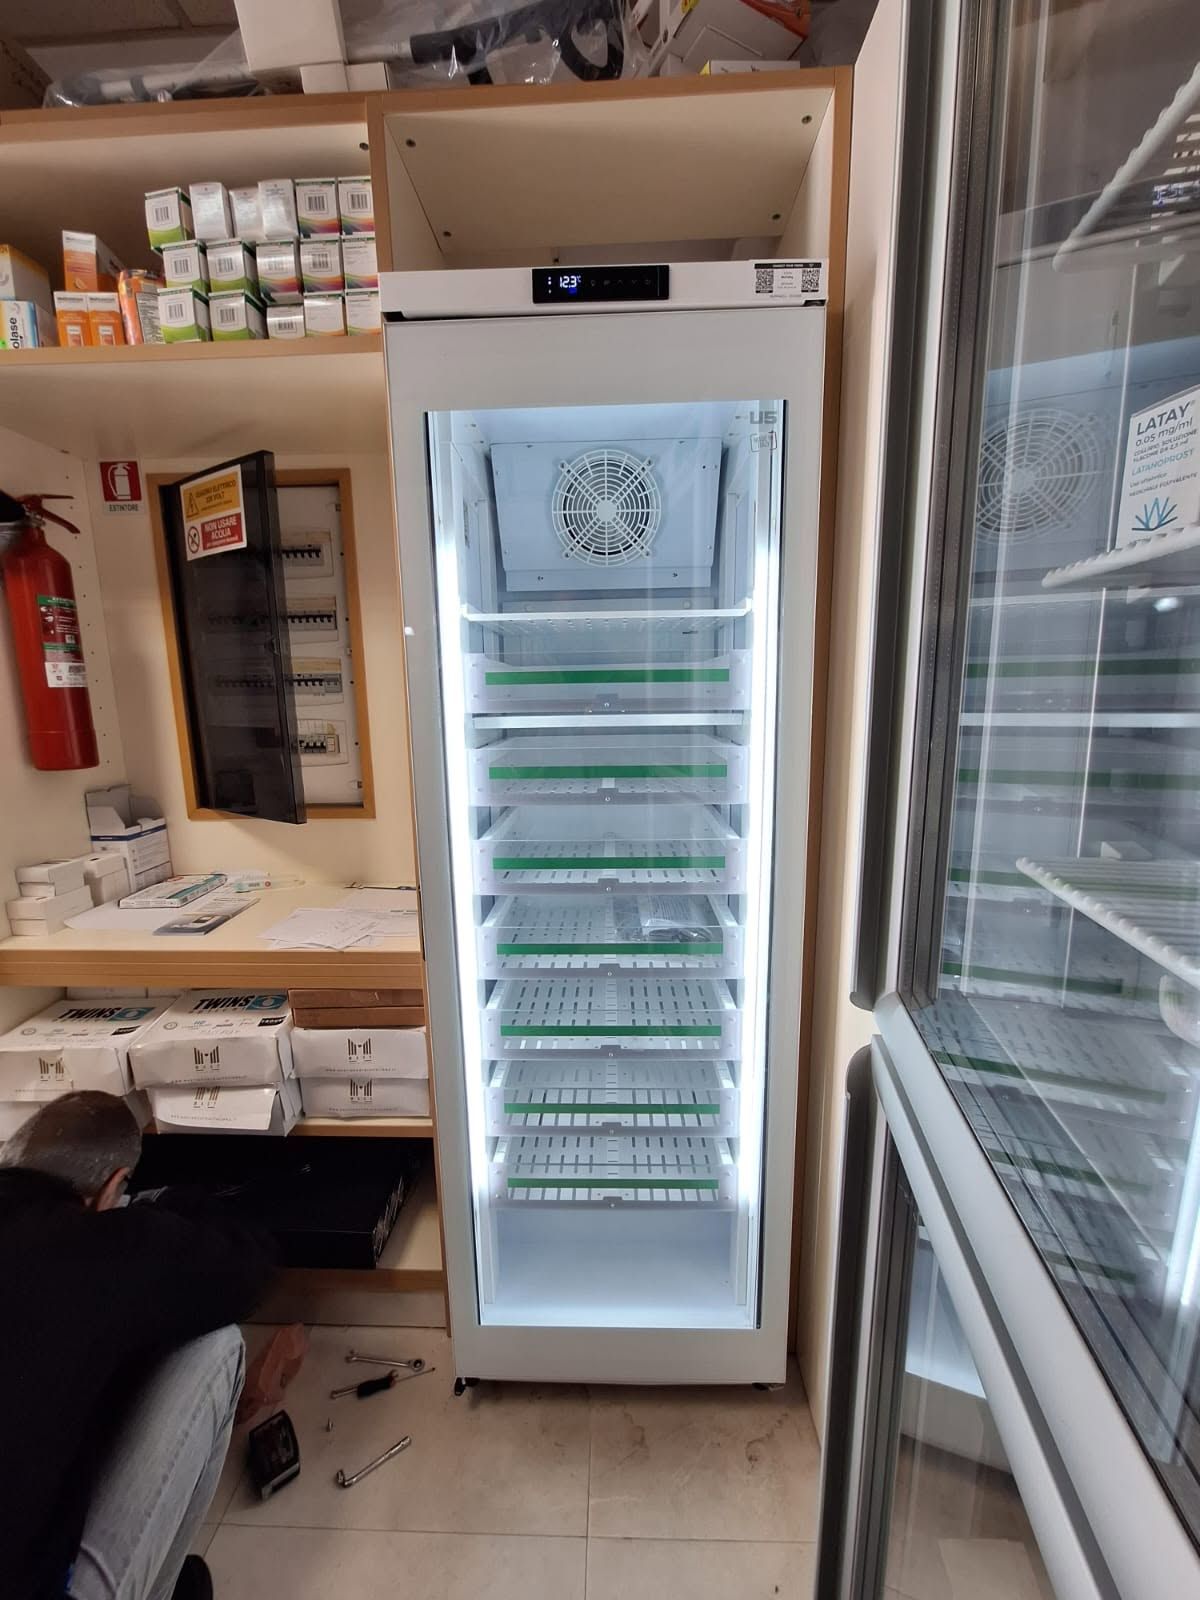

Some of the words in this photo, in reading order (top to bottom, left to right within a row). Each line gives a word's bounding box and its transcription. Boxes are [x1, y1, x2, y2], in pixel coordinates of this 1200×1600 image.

[1137, 402, 1190, 435] LATAY
[1135, 433, 1156, 447] 0.05
[1158, 416, 1193, 439] mg/ml
[1131, 448, 1194, 476] LATANOPROST
[109, 503, 138, 512] ESTINTORE
[204, 521, 218, 532] NON
[217, 515, 237, 529] USARE
[211, 527, 232, 540] ACQUA
[193, 995, 256, 1010] TWINS
[59, 1007, 122, 1019] TWINS
